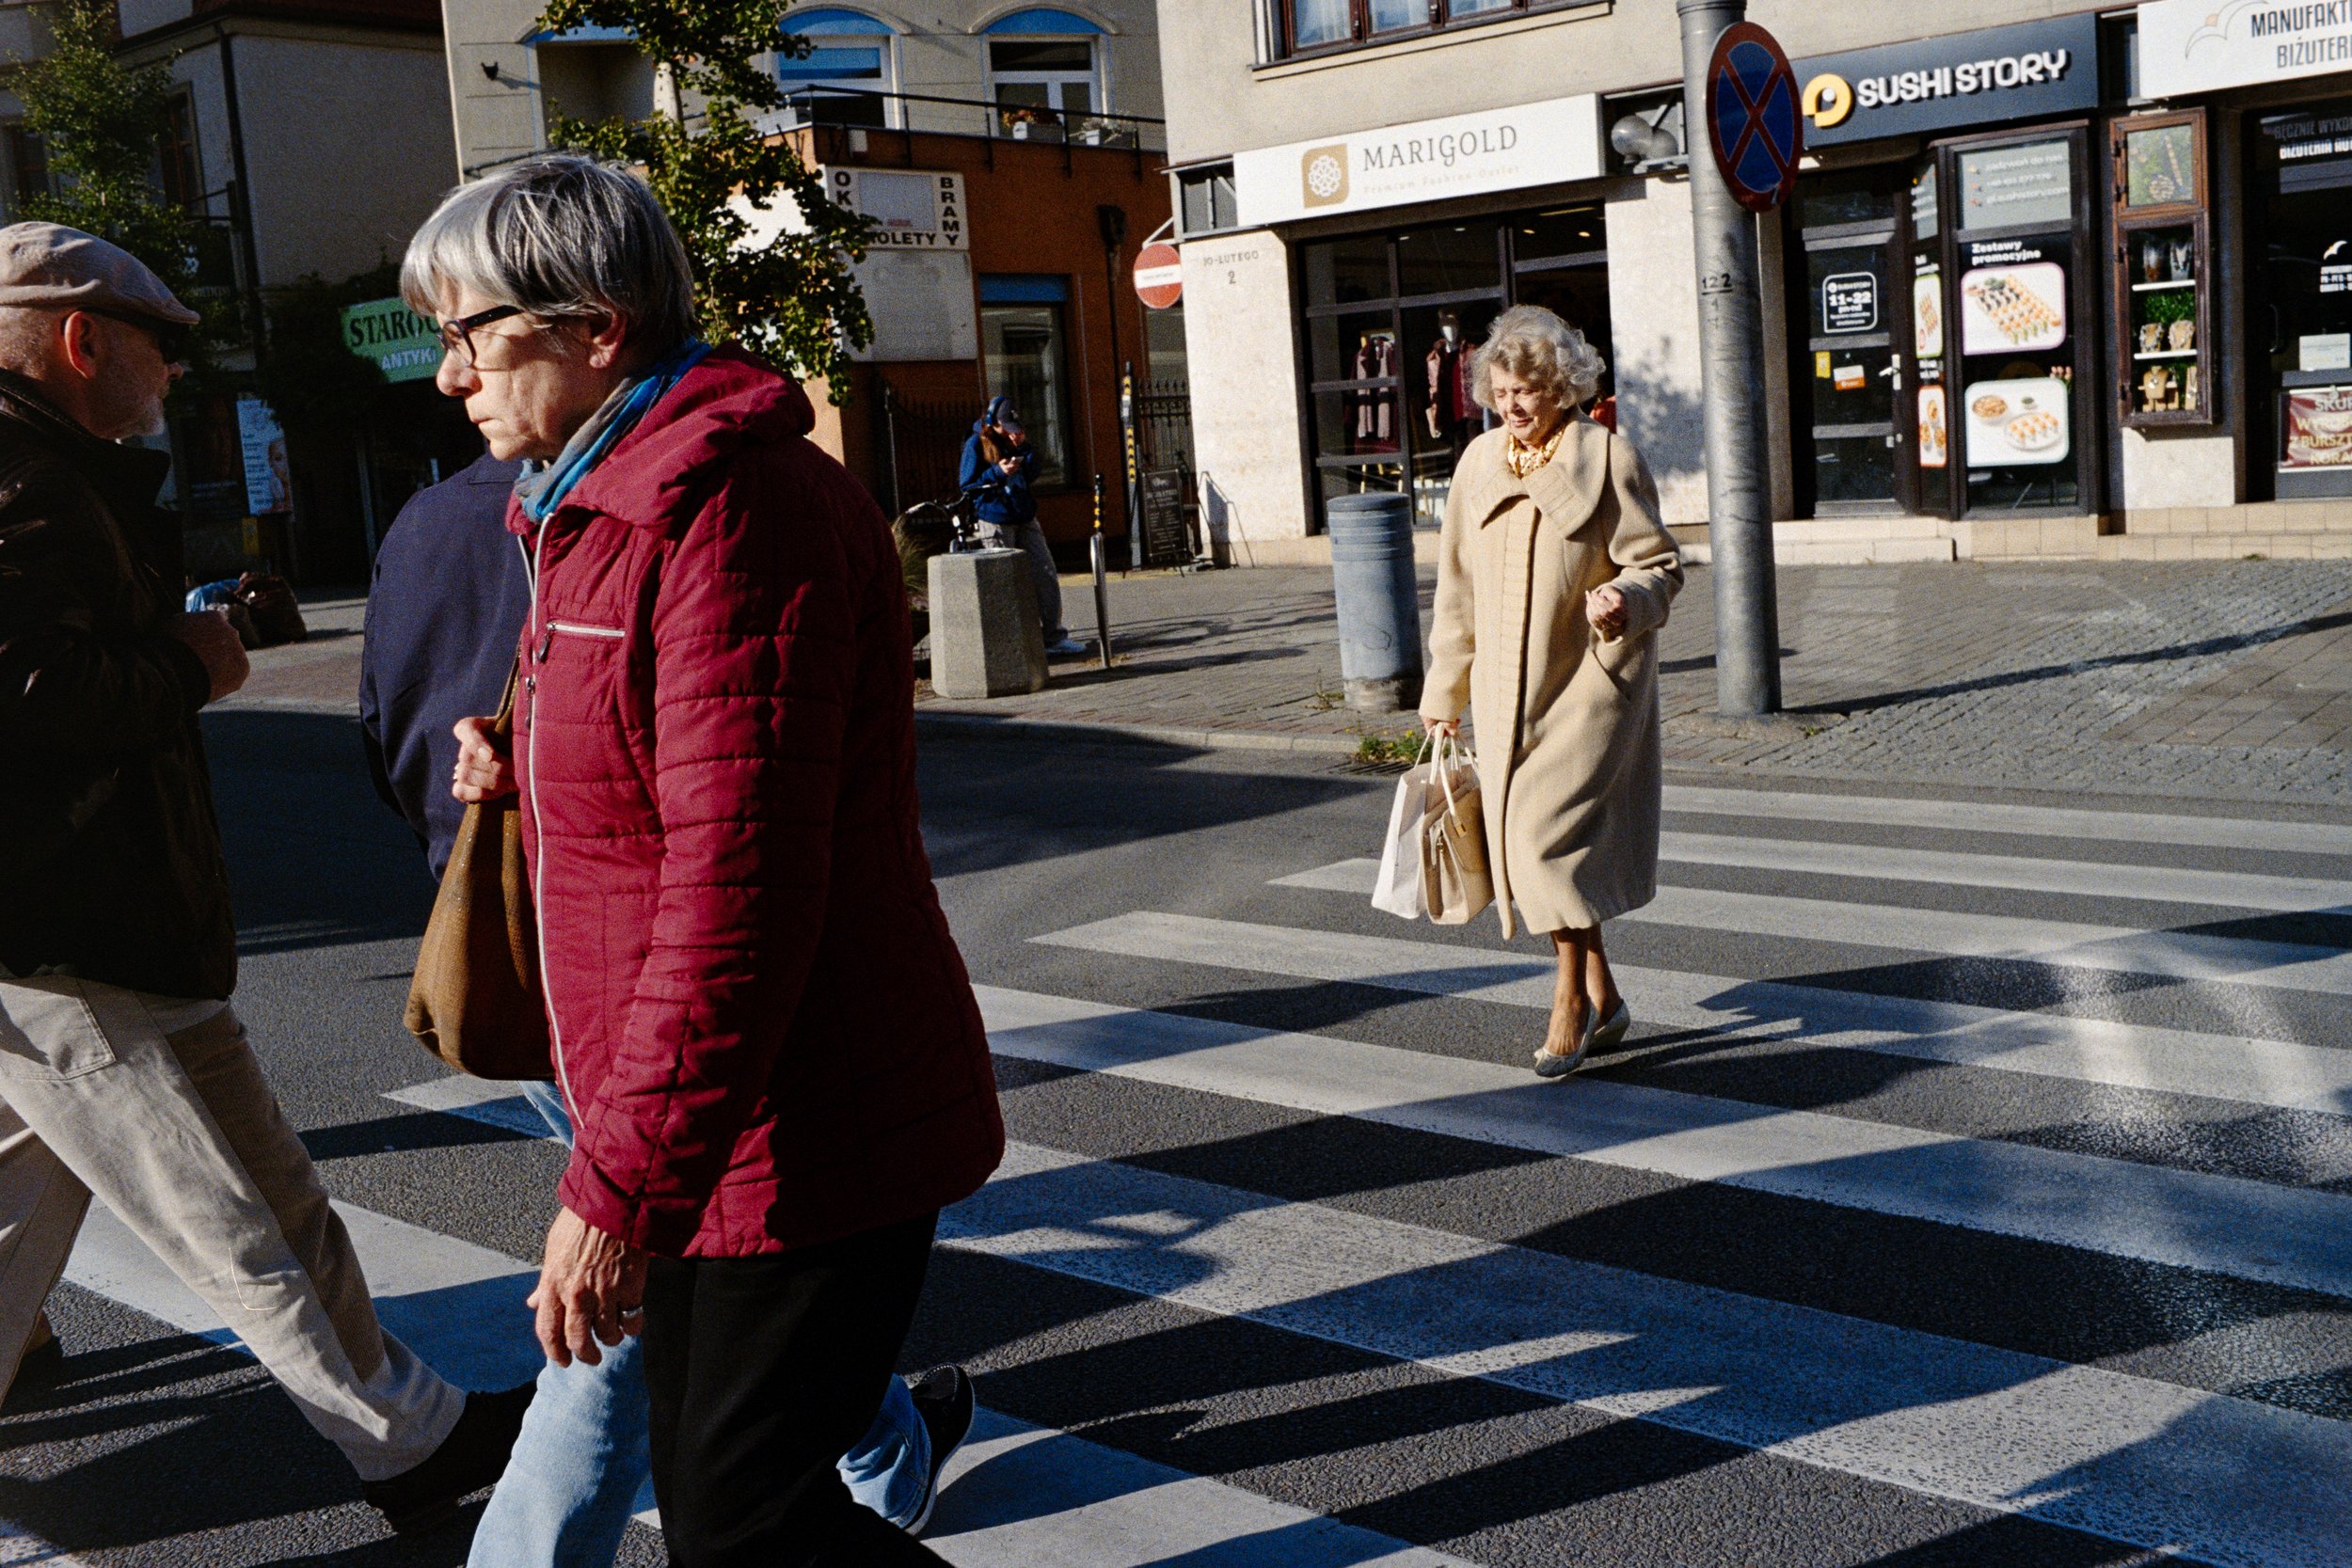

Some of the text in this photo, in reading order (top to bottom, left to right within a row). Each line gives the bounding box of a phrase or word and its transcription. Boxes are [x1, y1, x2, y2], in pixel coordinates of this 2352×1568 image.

[2251, 0, 2352, 38] MANUFAKT
[1857, 49, 2067, 107] SUSHI STORY
[2318, 117, 2352, 134] WYKO
[1363, 125, 1518, 171] MARIGOLD
[940, 177, 960, 246] BRAMY
[1971, 241, 2023, 254] Zestawy
[1971, 249, 2042, 266] promocyjne
[1228, 271, 1236, 285] 2
[1828, 291, 1872, 307] 11-22
